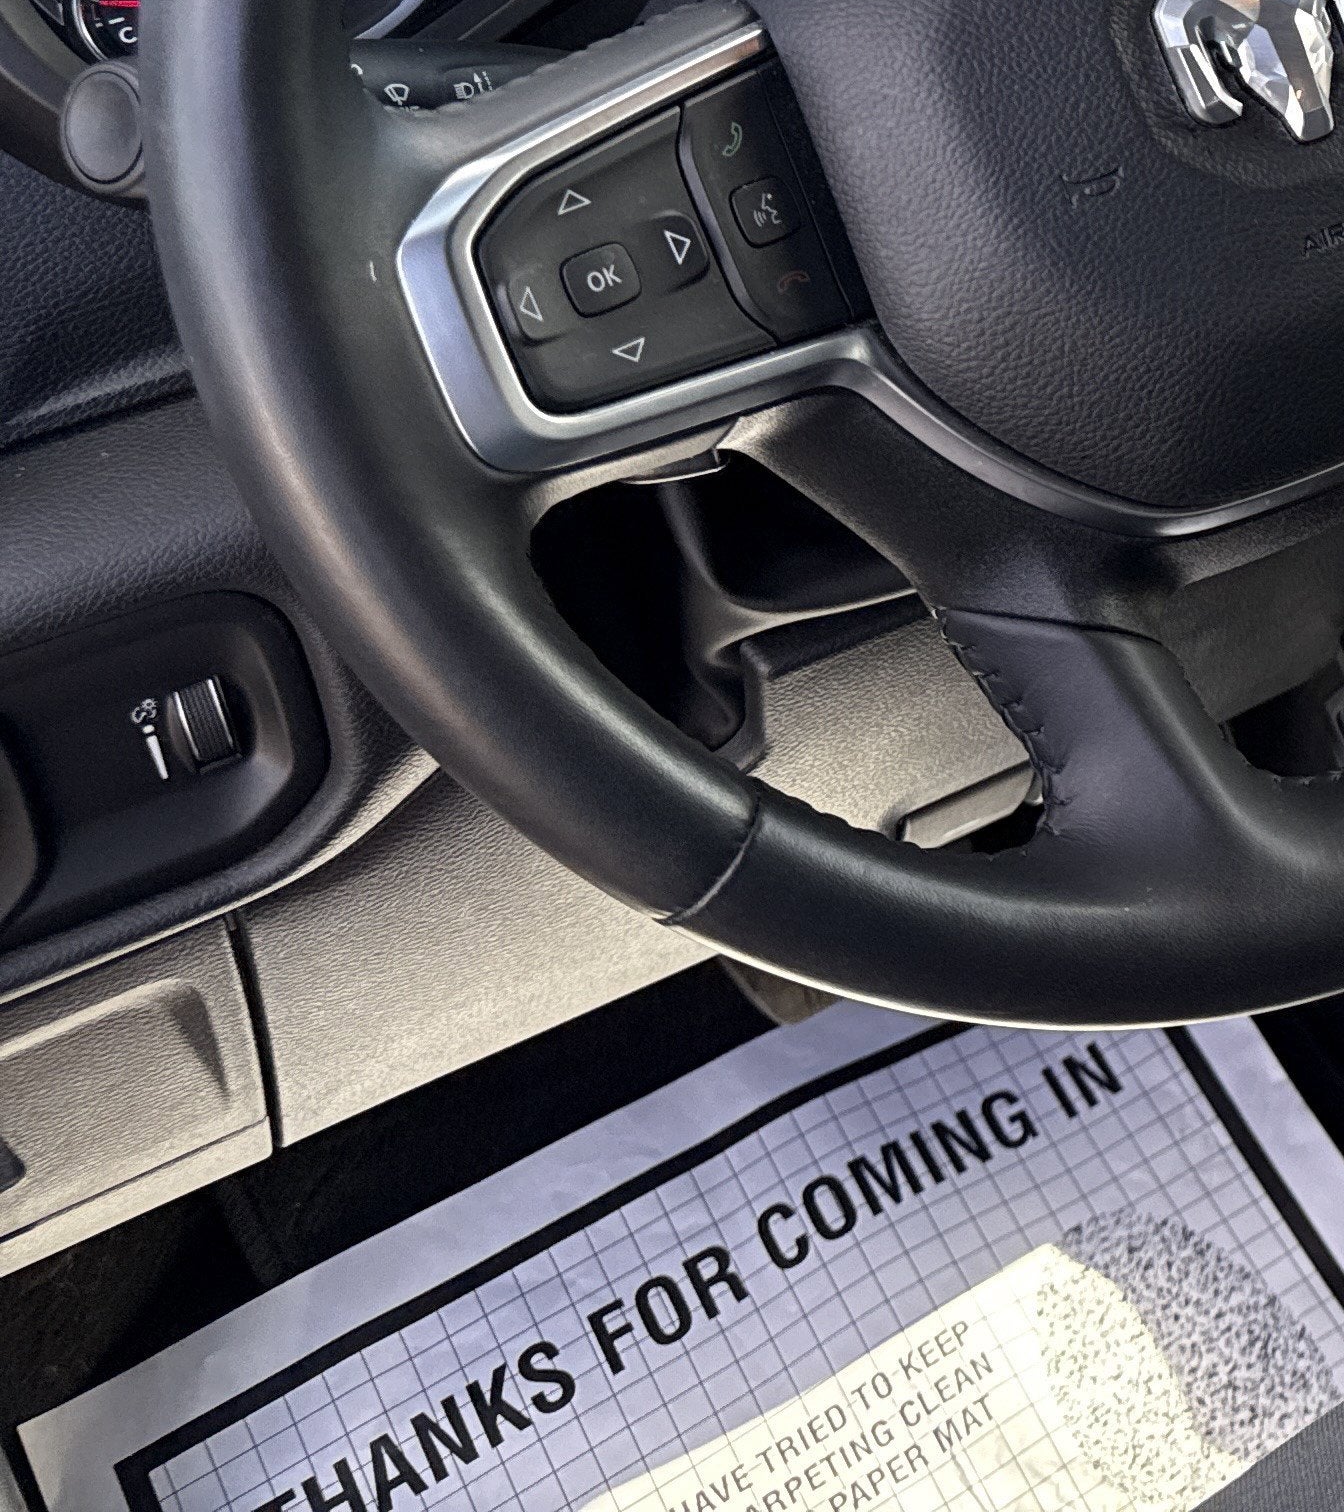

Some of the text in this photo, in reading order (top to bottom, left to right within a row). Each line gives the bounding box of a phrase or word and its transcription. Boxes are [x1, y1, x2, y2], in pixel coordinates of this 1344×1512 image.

[586, 264, 623, 293] OK
[586, 1245, 750, 1376] FOR
[756, 1089, 1040, 1269] COMING
[1041, 1041, 1124, 1120] IN
[755, 1404, 848, 1474] TRIED
[851, 1372, 893, 1410] TO
[898, 1320, 969, 1381] KEEP
[898, 1352, 995, 1427] CLEAN
[828, 1392, 996, 1512] PAPER MAT
